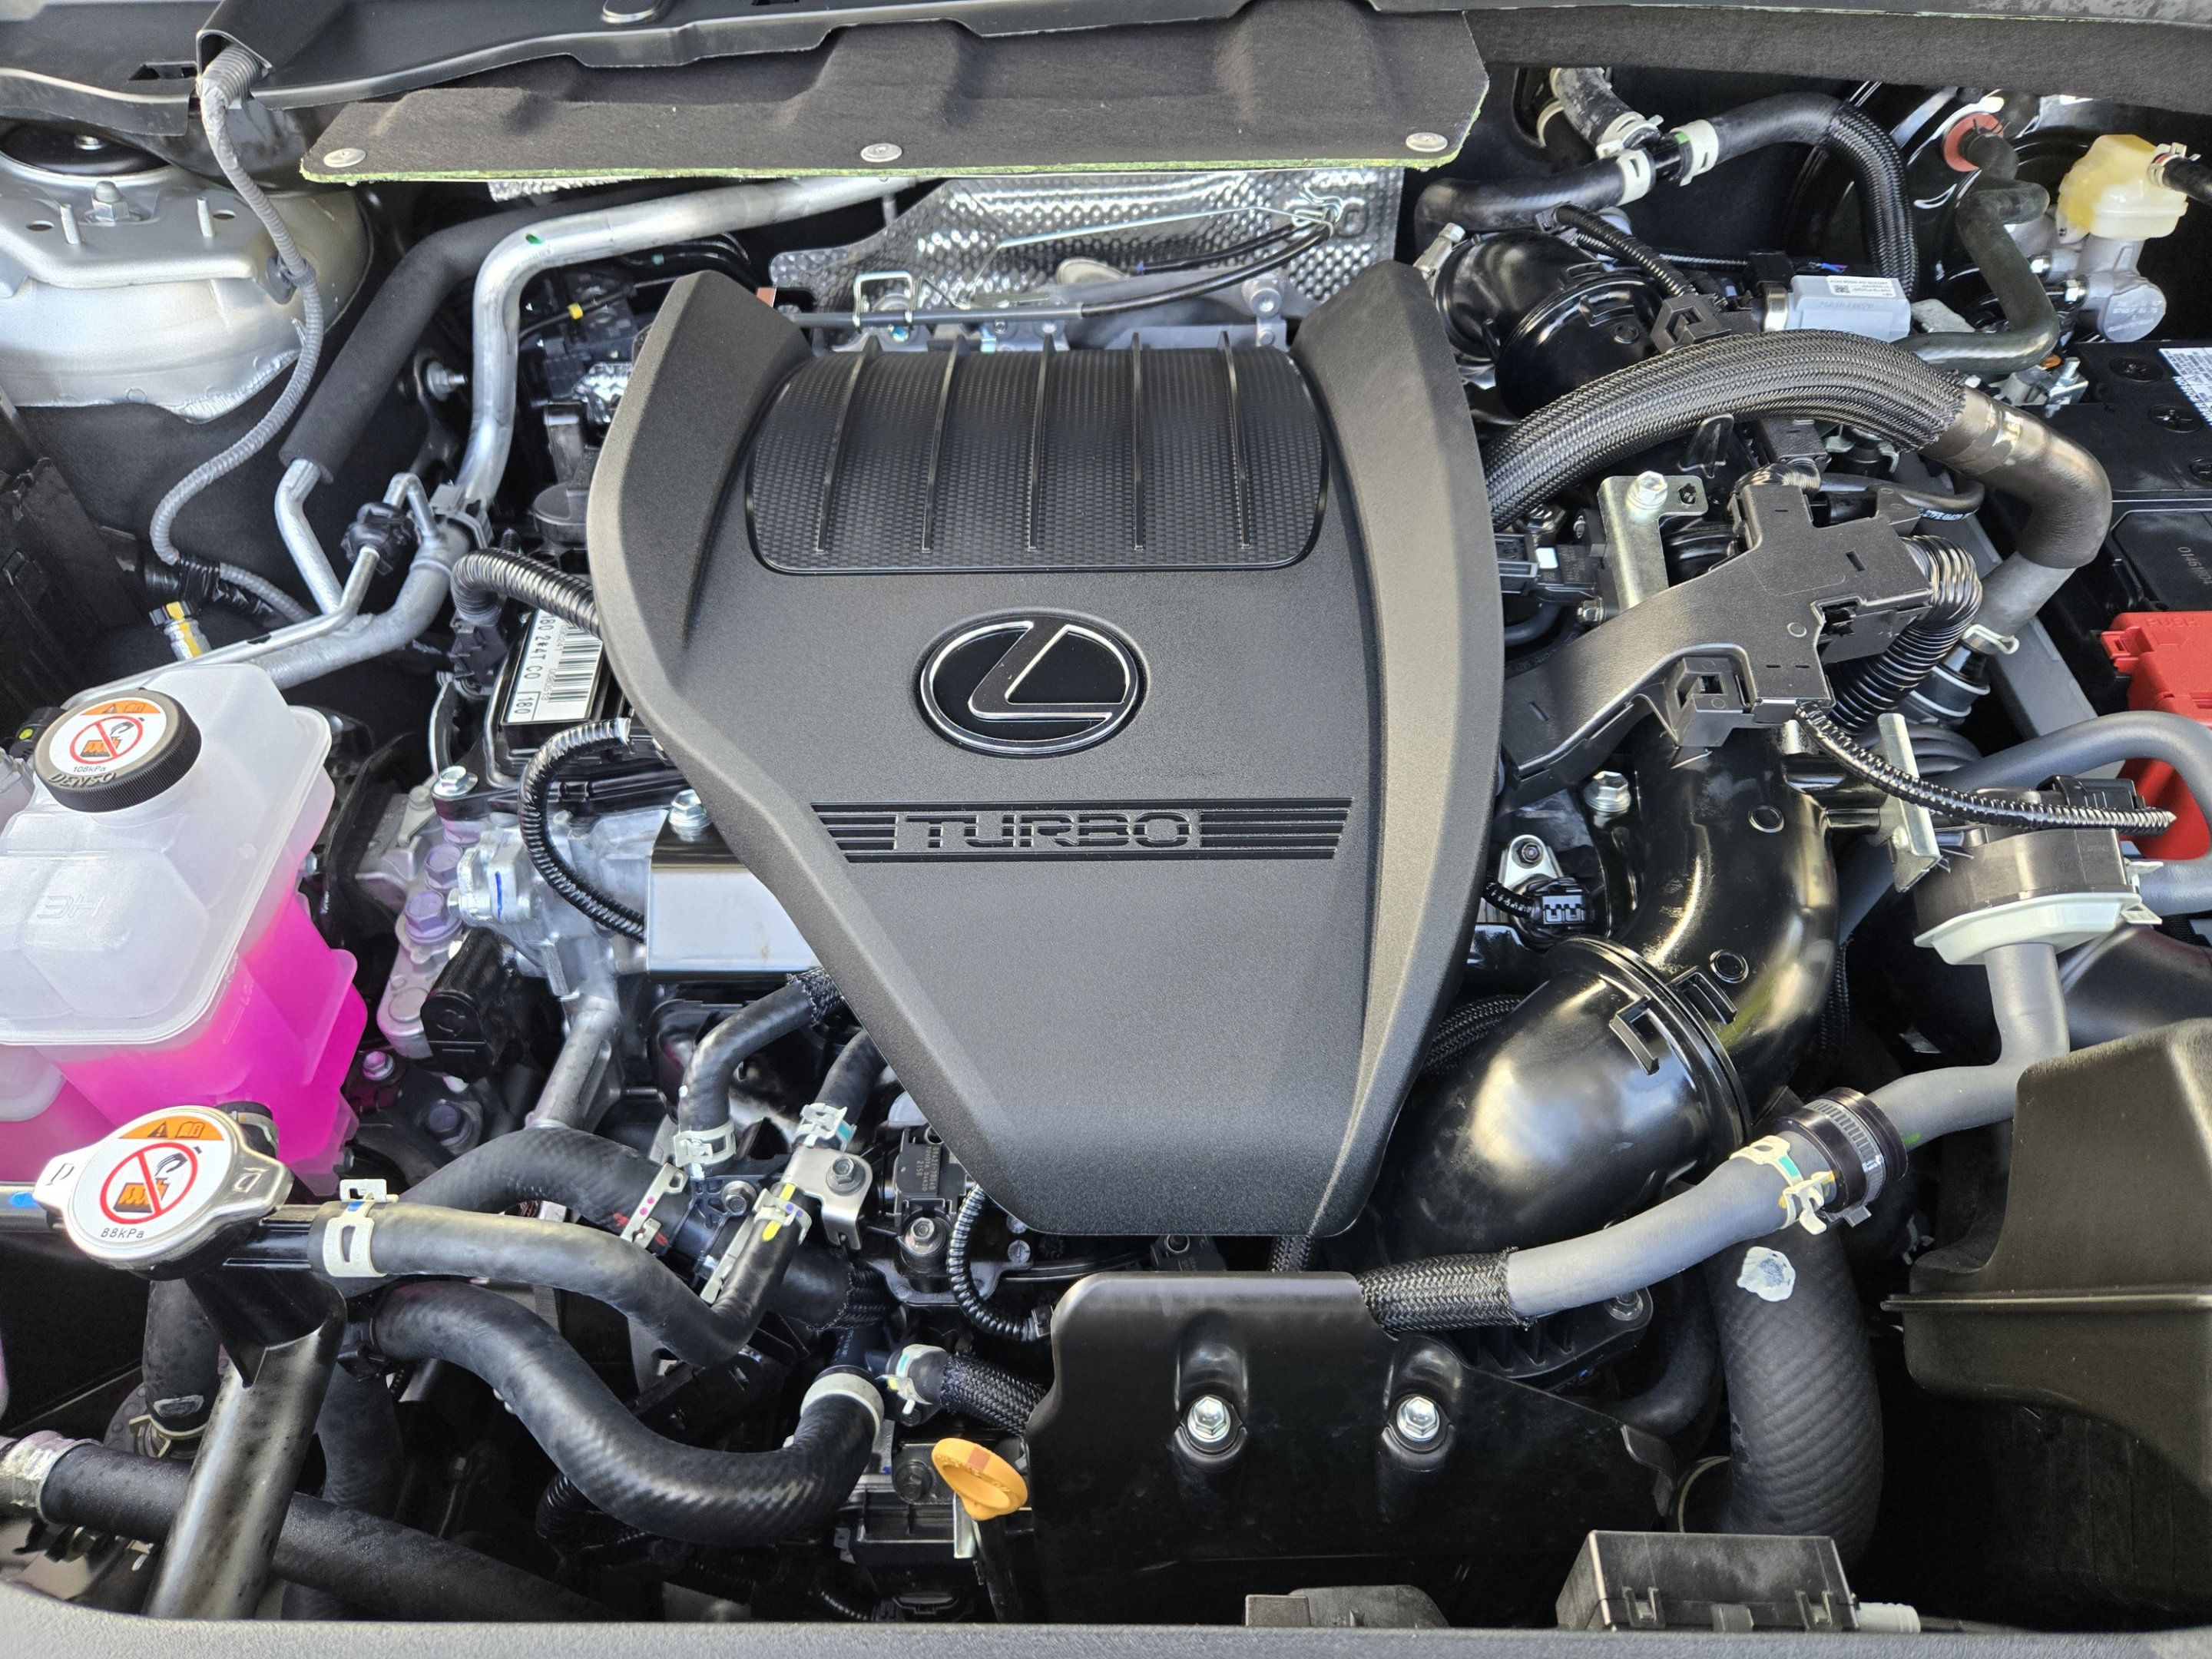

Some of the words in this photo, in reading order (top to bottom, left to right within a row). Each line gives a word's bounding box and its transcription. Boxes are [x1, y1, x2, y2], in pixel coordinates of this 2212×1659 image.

[514, 697, 535, 714] 180
[48, 773, 117, 788] DENSO
[906, 811, 1191, 848] TURBO
[101, 1227, 145, 1239] 88kPa
